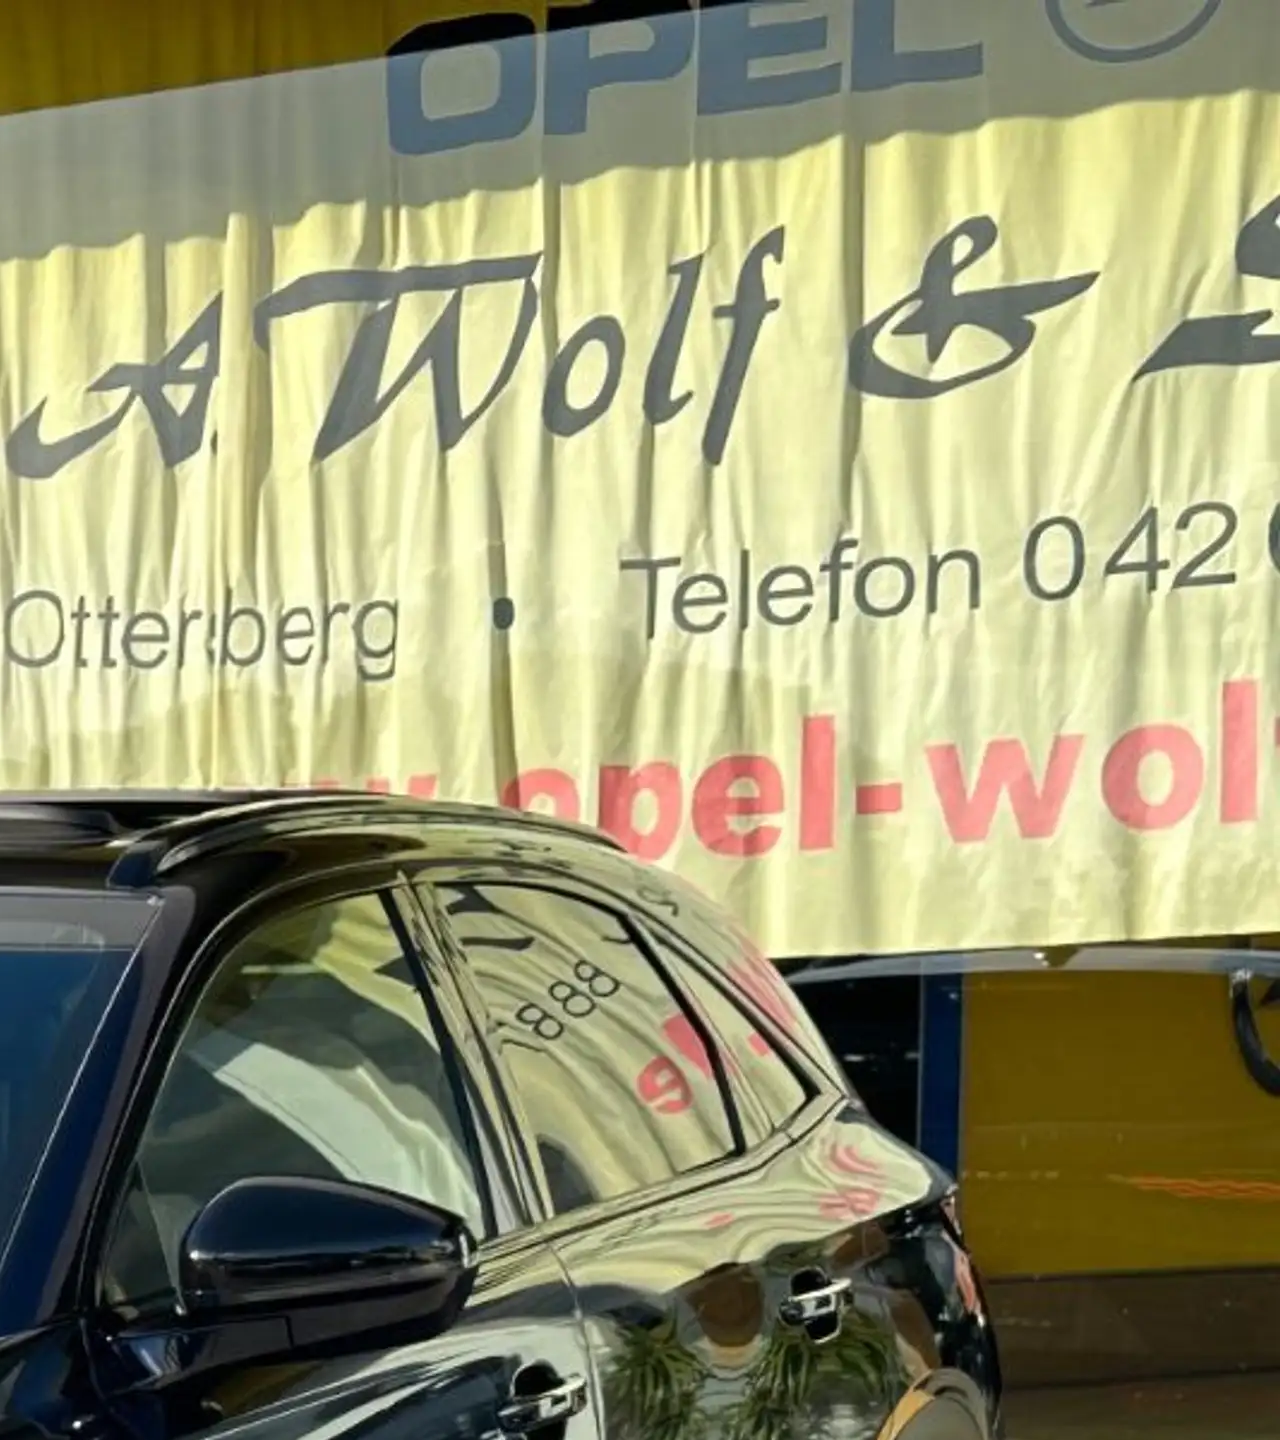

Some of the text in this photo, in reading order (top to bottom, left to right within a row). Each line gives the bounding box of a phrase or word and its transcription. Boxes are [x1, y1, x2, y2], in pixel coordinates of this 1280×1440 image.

[385, 0, 983, 156] OPEL
[5, 290, 221, 478] A
[254, 225, 785, 466] Wolf
[848, 214, 1100, 399] &
[619, 537, 981, 640] Telefon
